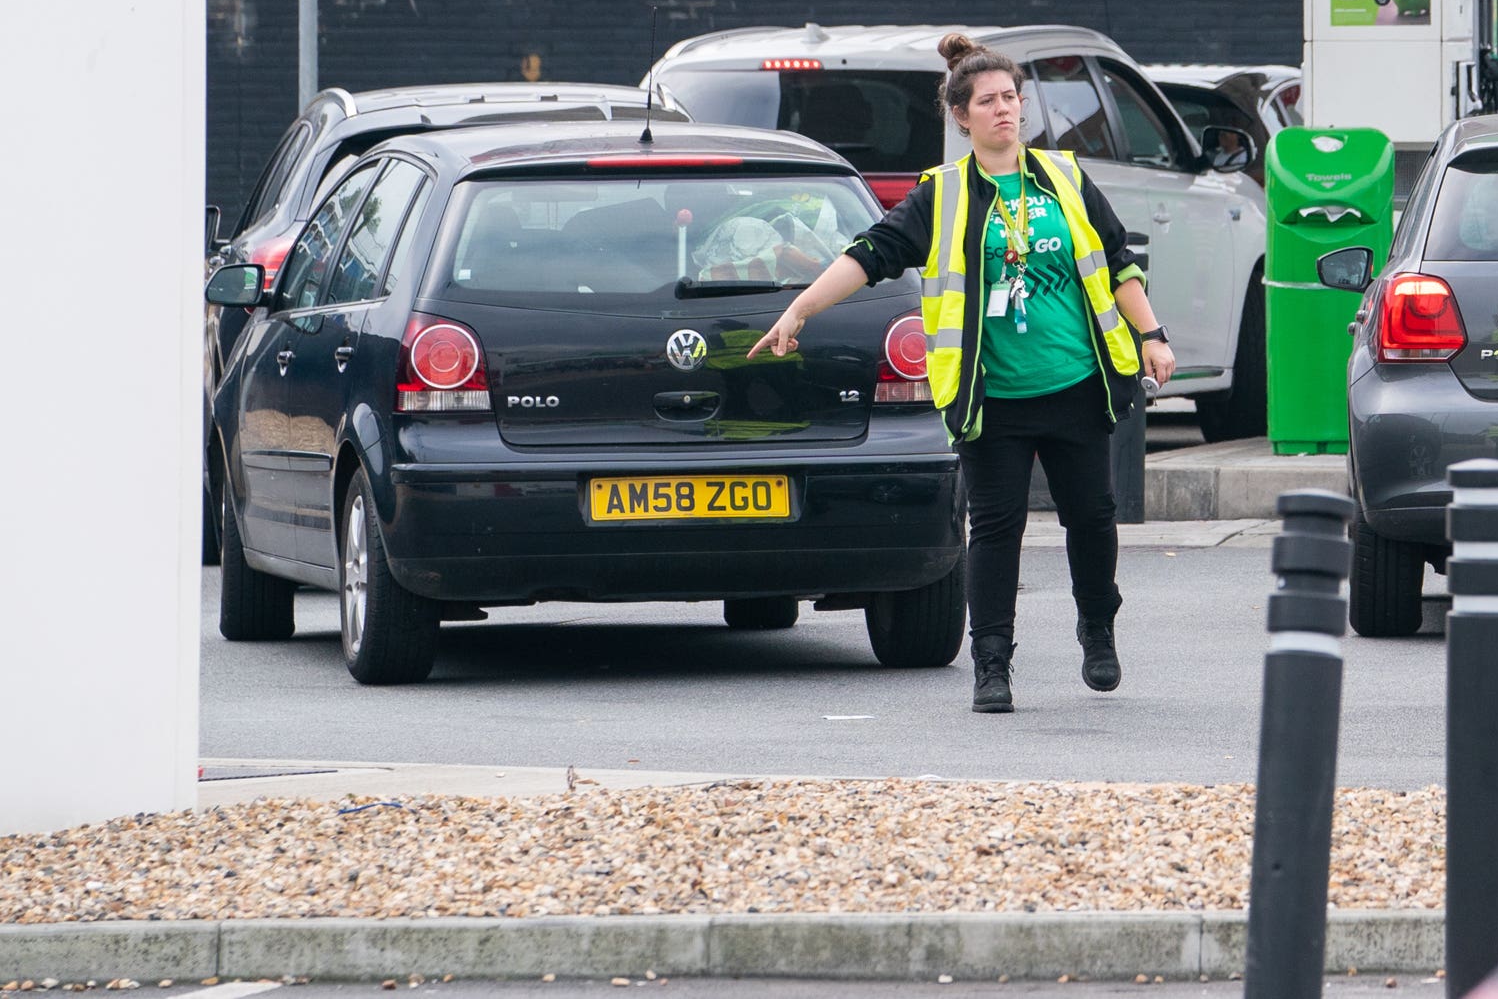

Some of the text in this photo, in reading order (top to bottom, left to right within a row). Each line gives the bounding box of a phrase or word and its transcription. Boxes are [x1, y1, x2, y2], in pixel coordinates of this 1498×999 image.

[1305, 173, 1352, 181] Towels
[507, 395, 560, 408] POLO
[606, 480, 772, 515] AM58 ZGO
